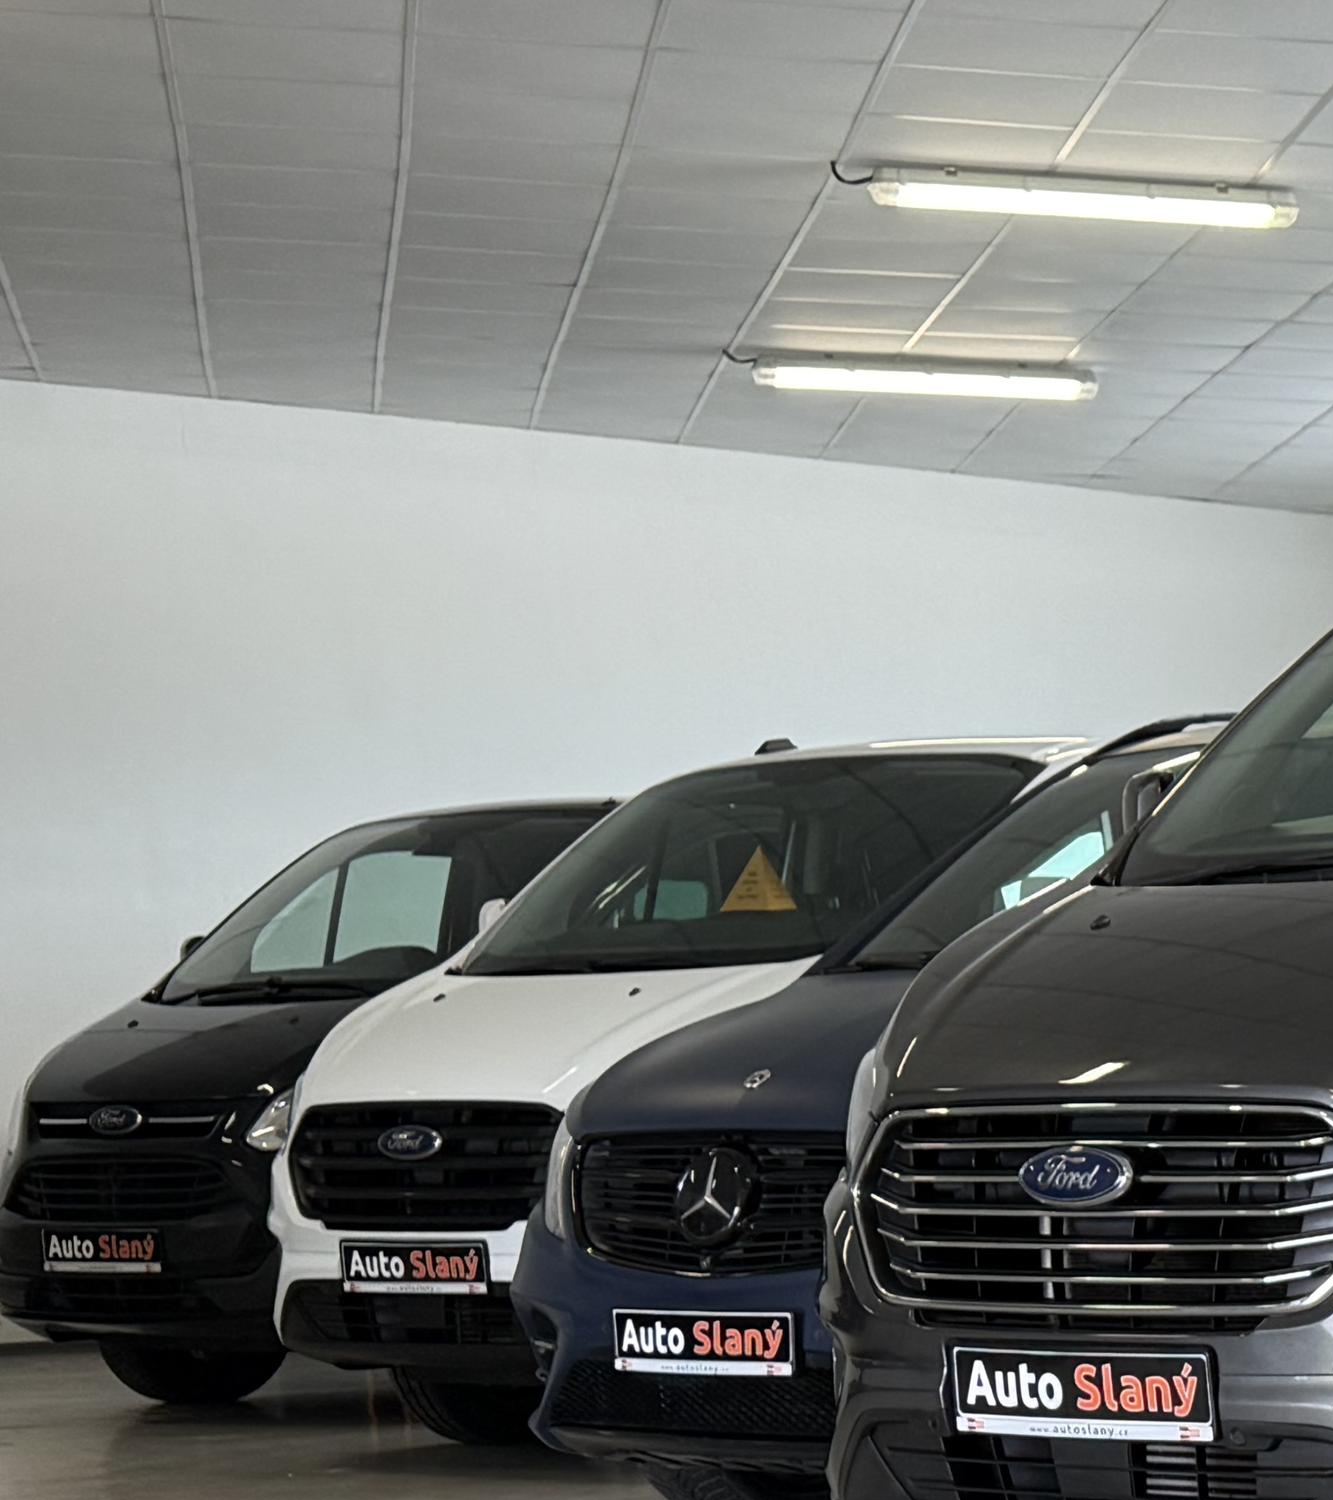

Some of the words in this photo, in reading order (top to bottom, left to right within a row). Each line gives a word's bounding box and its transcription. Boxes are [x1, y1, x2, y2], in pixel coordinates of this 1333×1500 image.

[1037, 1154, 1101, 1191] Ford
[49, 1235, 94, 1259] Auto
[98, 1234, 155, 1261] Slaný
[350, 1250, 405, 1279] Auto
[409, 1249, 479, 1280] Slaný
[621, 1318, 686, 1355] Auto
[692, 1319, 784, 1360] Slaný
[966, 1359, 1063, 1410] Auto
[1074, 1362, 1198, 1418] Slaný
